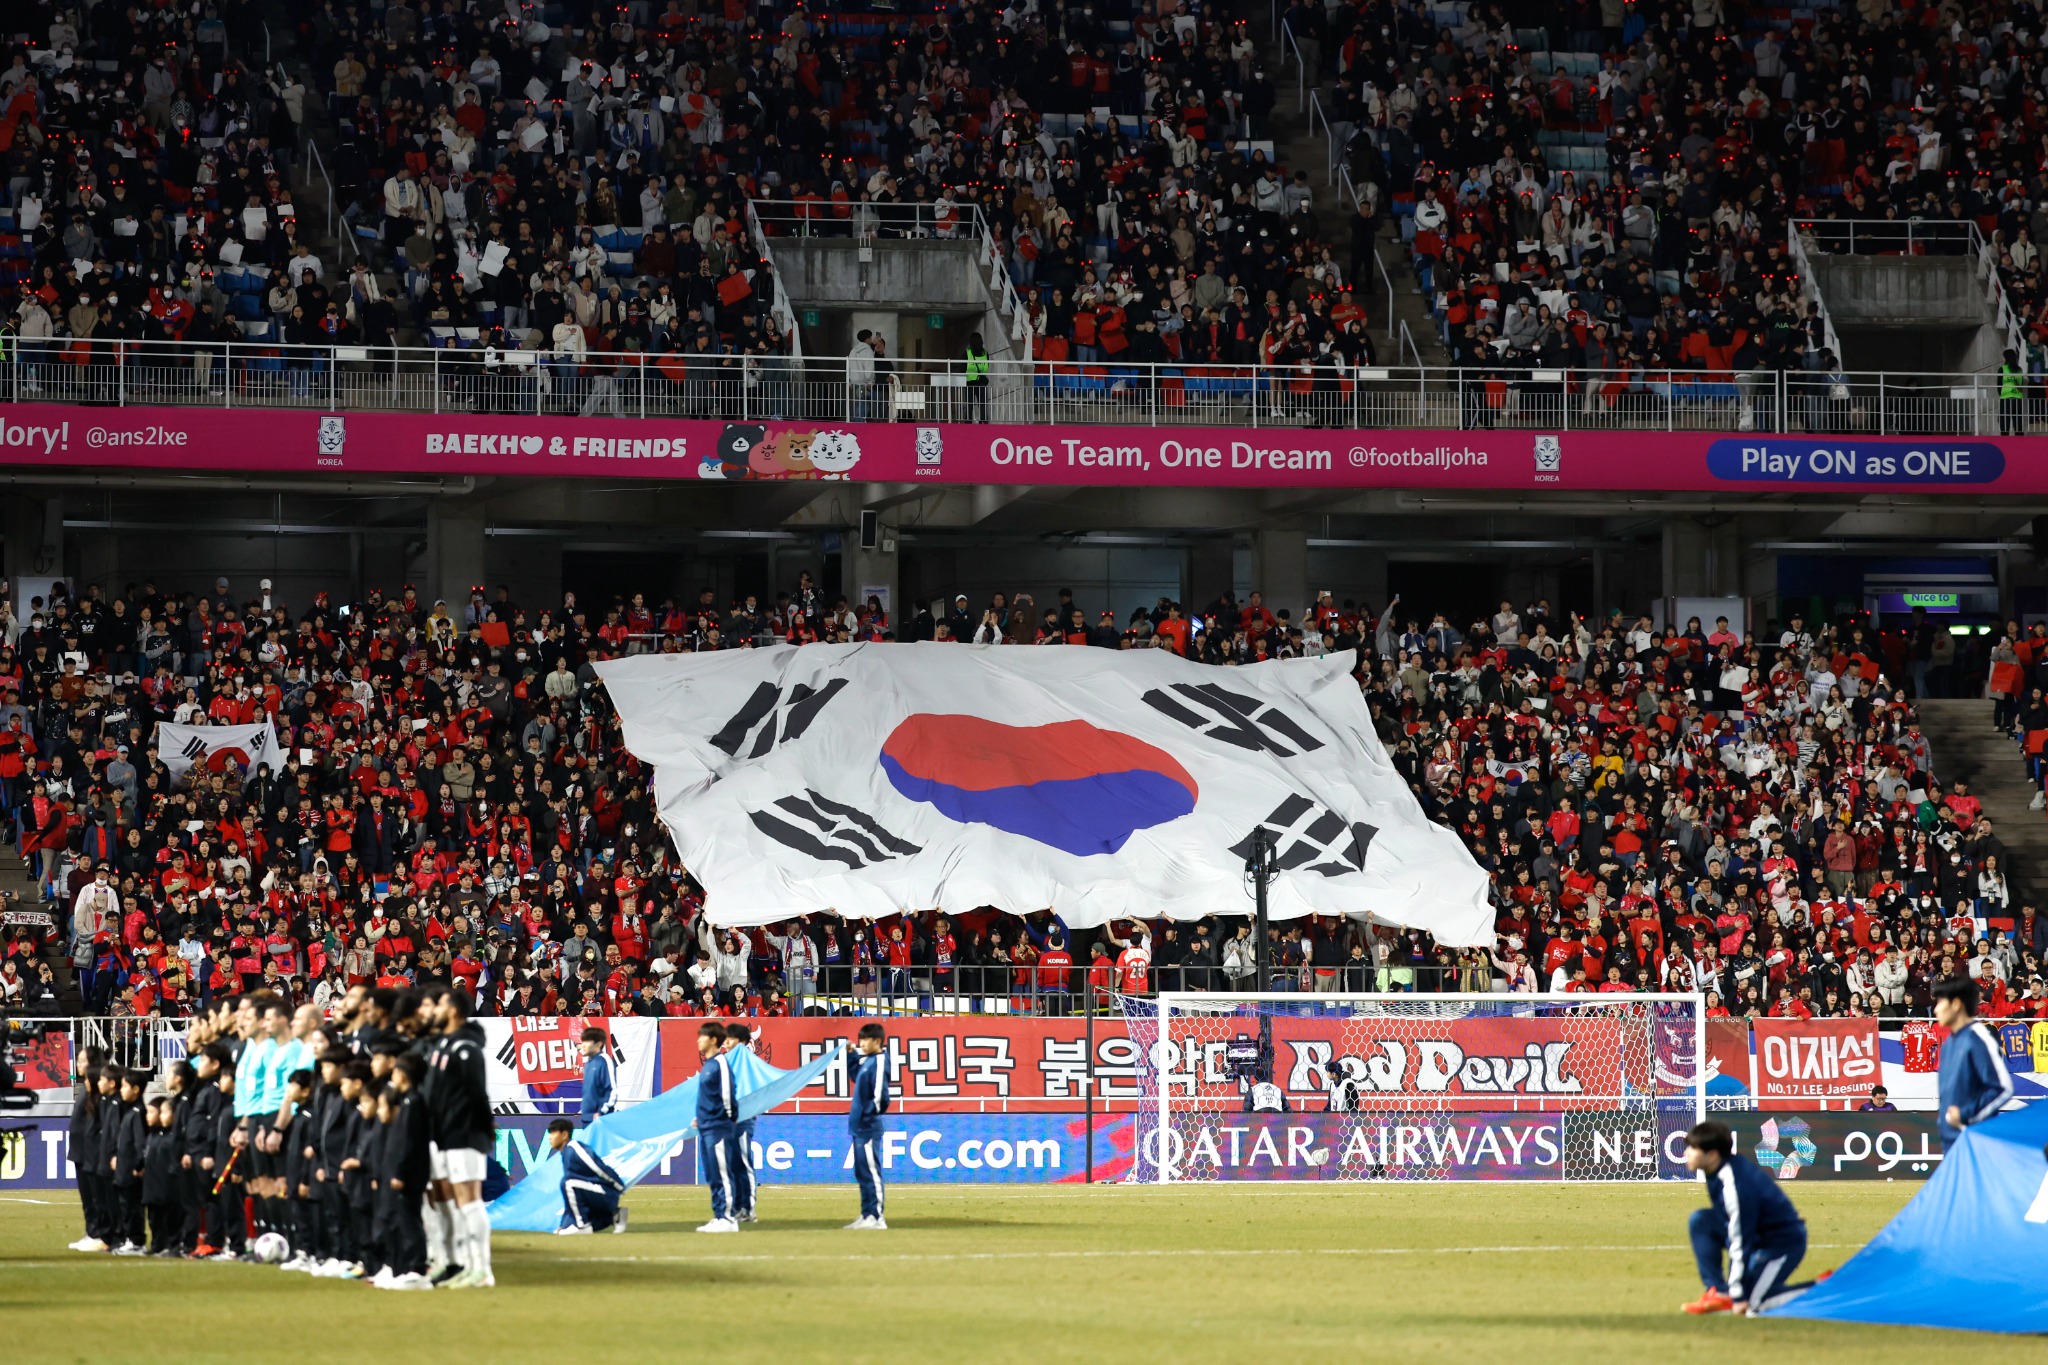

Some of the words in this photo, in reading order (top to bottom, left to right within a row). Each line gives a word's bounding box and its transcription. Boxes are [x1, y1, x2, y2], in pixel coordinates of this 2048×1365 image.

[86, 426, 188, 448] @ans2lxe
[548, 435, 568, 456] &
[572, 436, 687, 459] FRIENDS
[317, 458, 344, 466] KOREA
[990, 437, 1054, 466] One
[1060, 439, 1151, 471] Team,
[1159, 440, 1222, 468] One
[1231, 441, 1332, 470] Dream
[1348, 446, 1489, 471] @footballjoha
[1742, 446, 1802, 479] Play
[1808, 449, 1856, 475] ON
[1865, 456, 1897, 476] as
[1902, 450, 1970, 476] ONE
[915, 468, 941, 476] KOREA
[1534, 474, 1560, 482] KOREA
[1911, 593, 1936, 602] Nice
[1938, 593, 1950, 602] to
[10, 913, 48, 922] 대한민국
[1046, 957, 1069, 965] KOREA
[1129, 960, 1146, 979] 20
[1913, 1034, 1923, 1053] 7
[2009, 1035, 2025, 1053] 15
[520, 1038, 592, 1072] 이태
[1283, 1039, 1407, 1093] Red
[1763, 1032, 1875, 1080] 이재성
[1767, 1082, 1799, 1095] NO.17
[1802, 1084, 1824, 1095] LEE
[1826, 1082, 1876, 1095] Jaesung
[842, 1129, 1061, 1170] FC.com
[1144, 1125, 1315, 1179] QATAR
[1340, 1125, 1559, 1167] AIRWAYS
[1593, 1130, 1738, 1165] NEO
[1833, 1131, 1945, 1172] يوم
